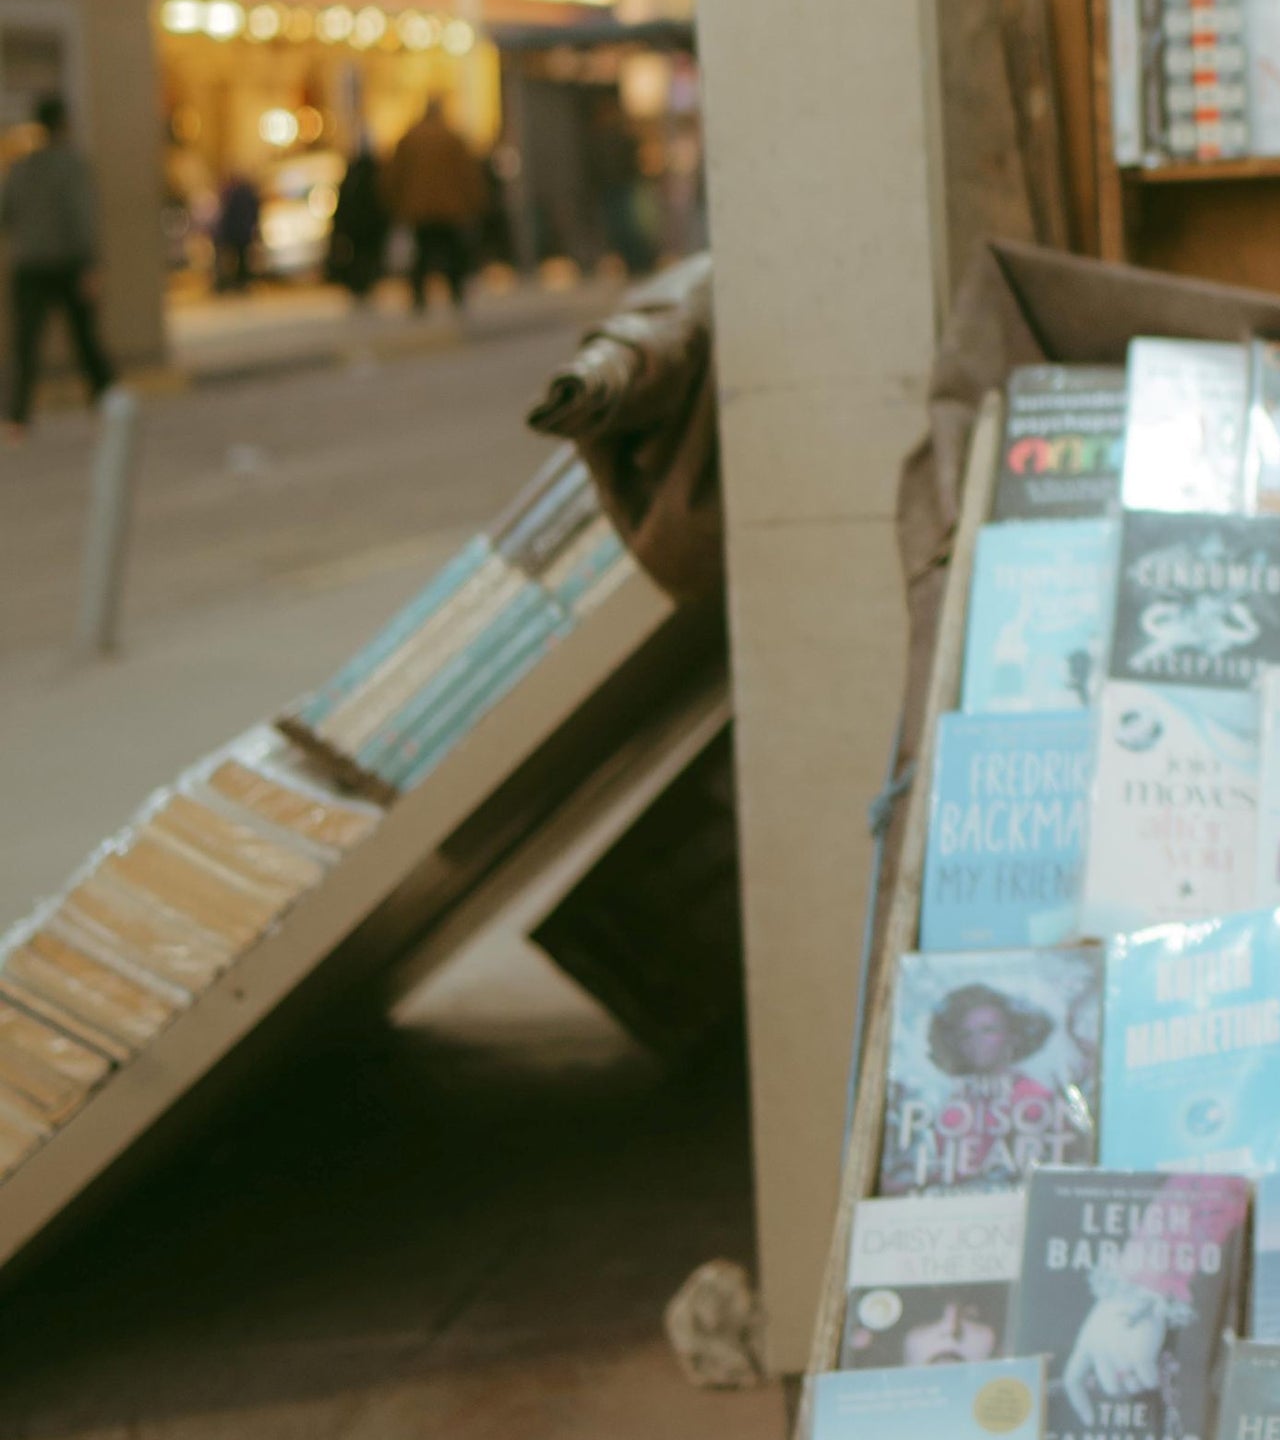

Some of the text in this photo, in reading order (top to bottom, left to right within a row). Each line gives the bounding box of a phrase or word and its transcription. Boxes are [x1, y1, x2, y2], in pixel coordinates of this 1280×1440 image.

[969, 749, 1089, 799] FREDRIK
[935, 863, 983, 906] MY
[902, 1097, 1082, 1152] POISON
[914, 1131, 1077, 1187] HEART
[1081, 1202, 1193, 1236] LEIGH
[861, 1225, 944, 1257] DAISY
[1046, 1235, 1222, 1275] BARDUGO
[1099, 1402, 1149, 1428] THE
